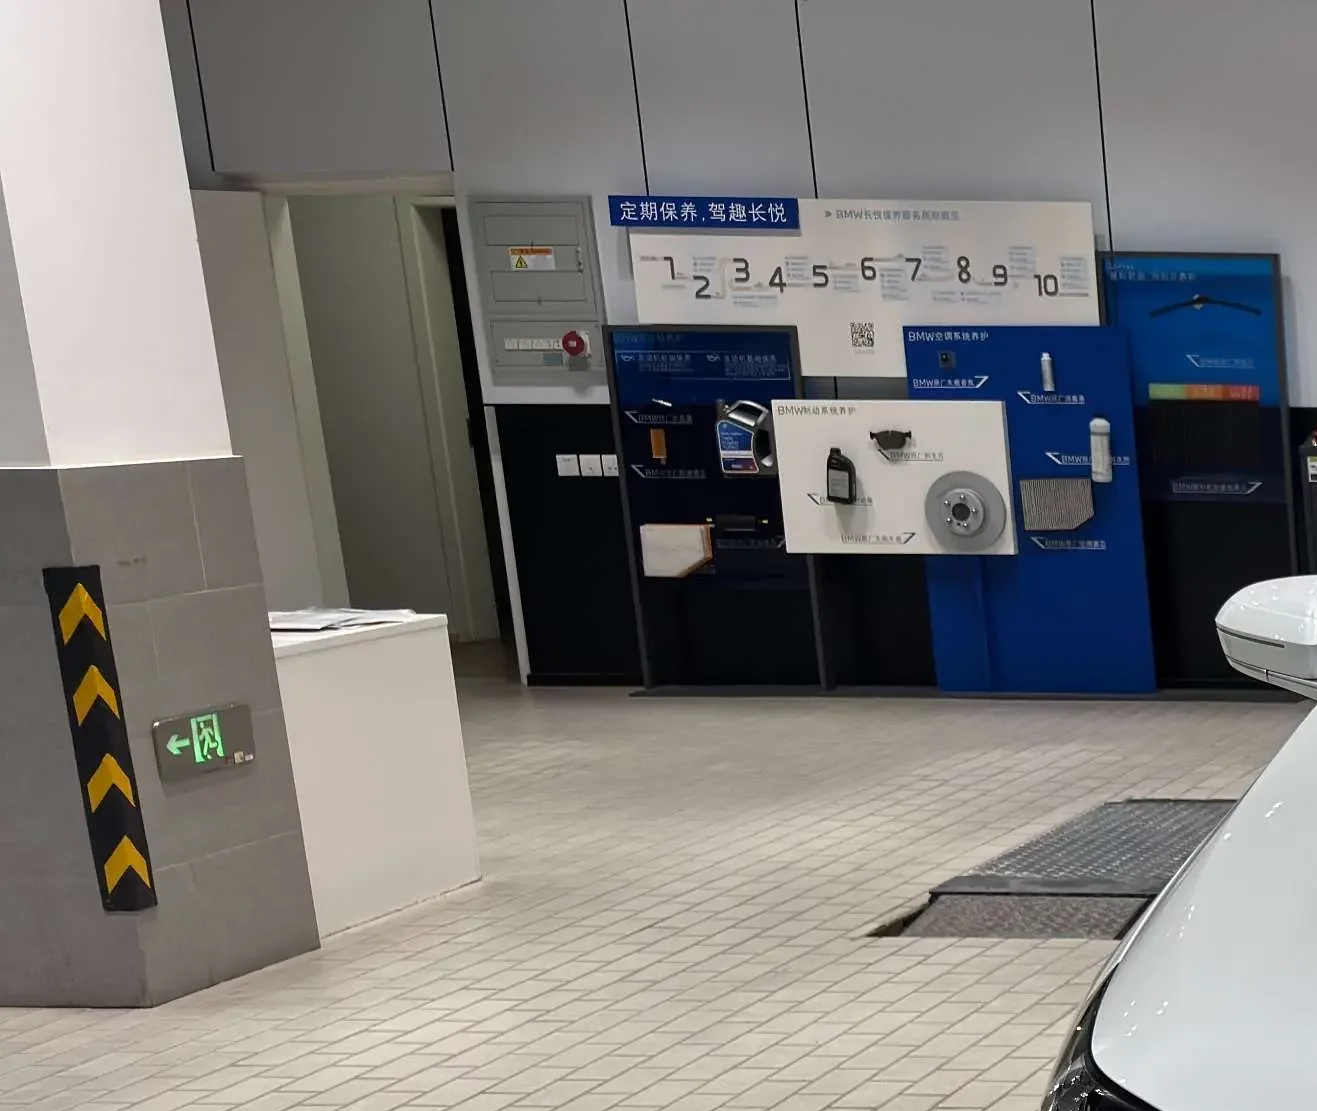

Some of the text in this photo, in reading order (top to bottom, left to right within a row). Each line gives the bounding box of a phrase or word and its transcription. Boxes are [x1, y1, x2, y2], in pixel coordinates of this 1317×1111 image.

[733, 257, 750, 282] 3
[769, 266, 787, 293] 4
[812, 264, 829, 288] 5
[860, 257, 877, 280] 6
[905, 257, 922, 281] 7
[957, 256, 972, 283] 8
[992, 264, 1008, 286] 9
[693, 275, 711, 299] 2
[1034, 274, 1059, 297] 10
